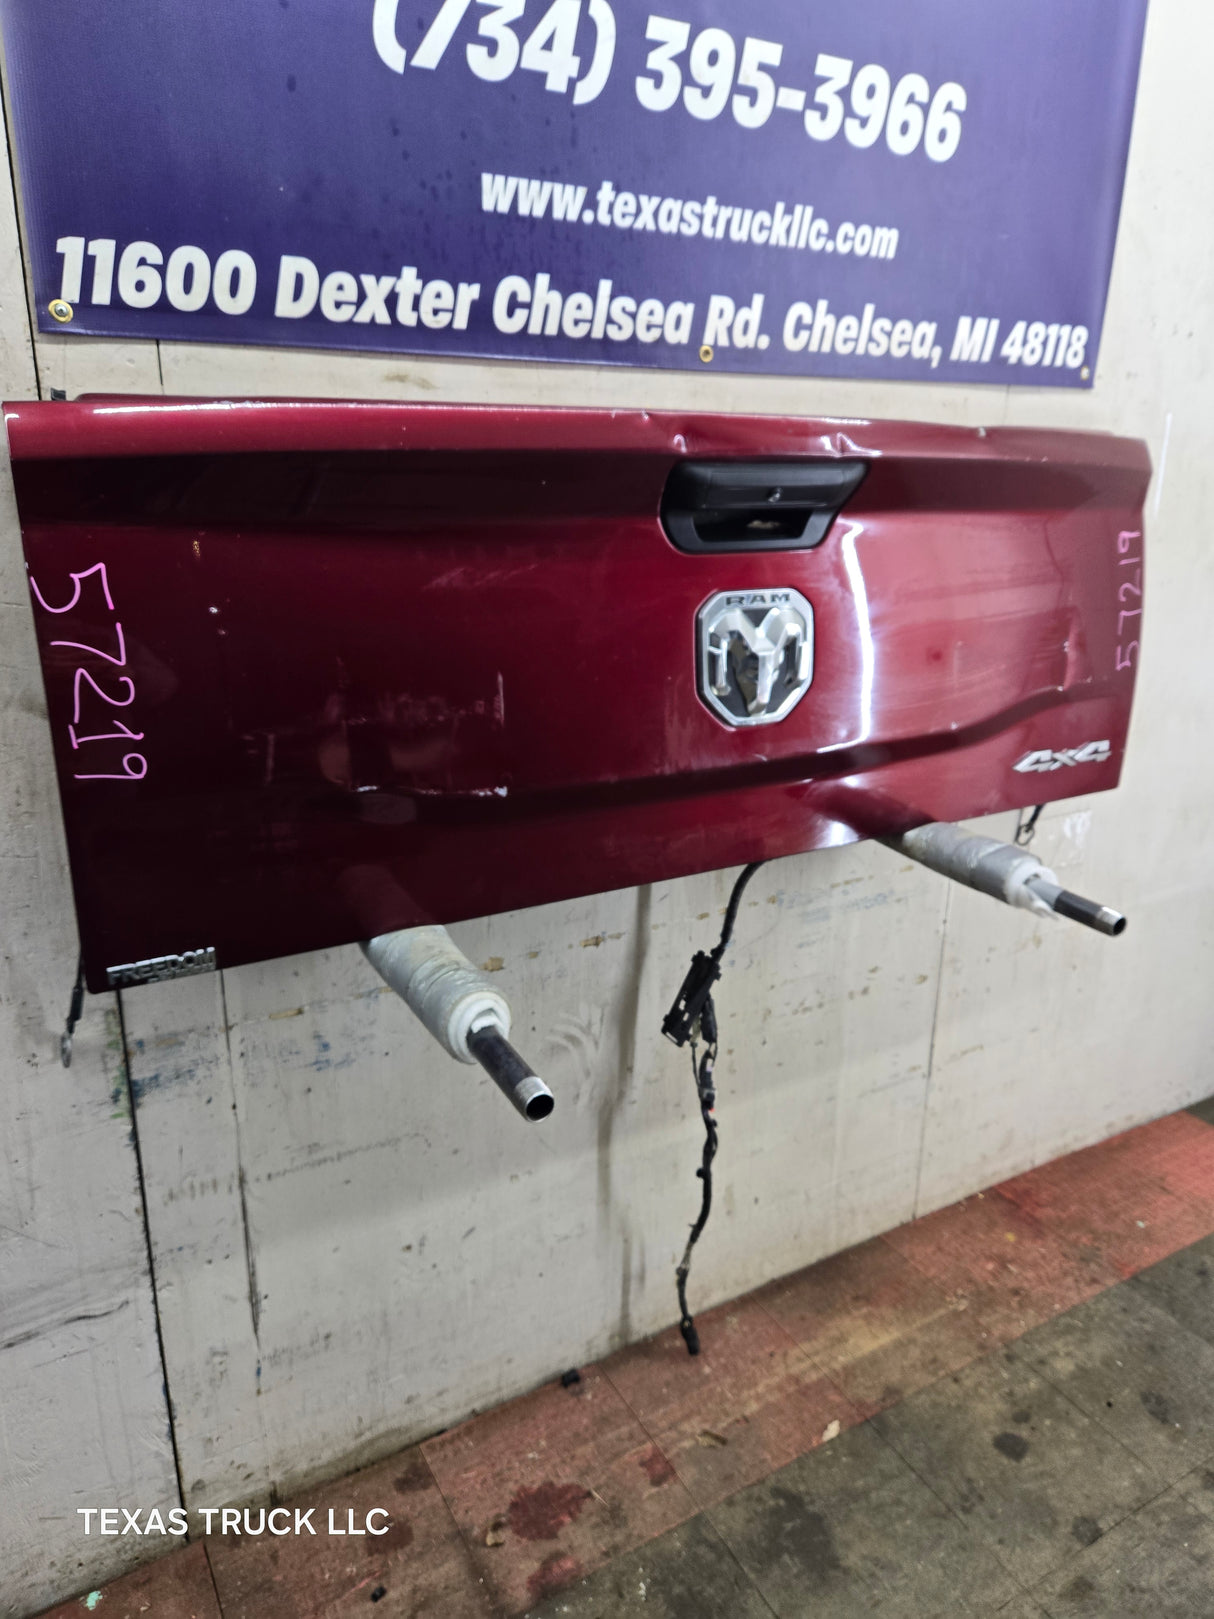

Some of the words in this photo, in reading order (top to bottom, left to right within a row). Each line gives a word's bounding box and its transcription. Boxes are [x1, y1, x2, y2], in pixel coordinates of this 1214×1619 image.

[372, 0, 616, 105] (734)
[635, 15, 967, 163] 395-3966
[481, 172, 899, 259] www.texastruckllc.com
[56, 236, 257, 315] 11600
[274, 254, 480, 330] Dexter
[492, 272, 695, 345] Chelsea
[703, 293, 771, 351] Rd.
[782, 298, 942, 369] Chelsea,
[950, 315, 999, 363] MI
[1000, 320, 1090, 369] 48118
[725, 592, 790, 606] RAM
[1116, 530, 1142, 671] 57219
[30, 562, 148, 779] 57219
